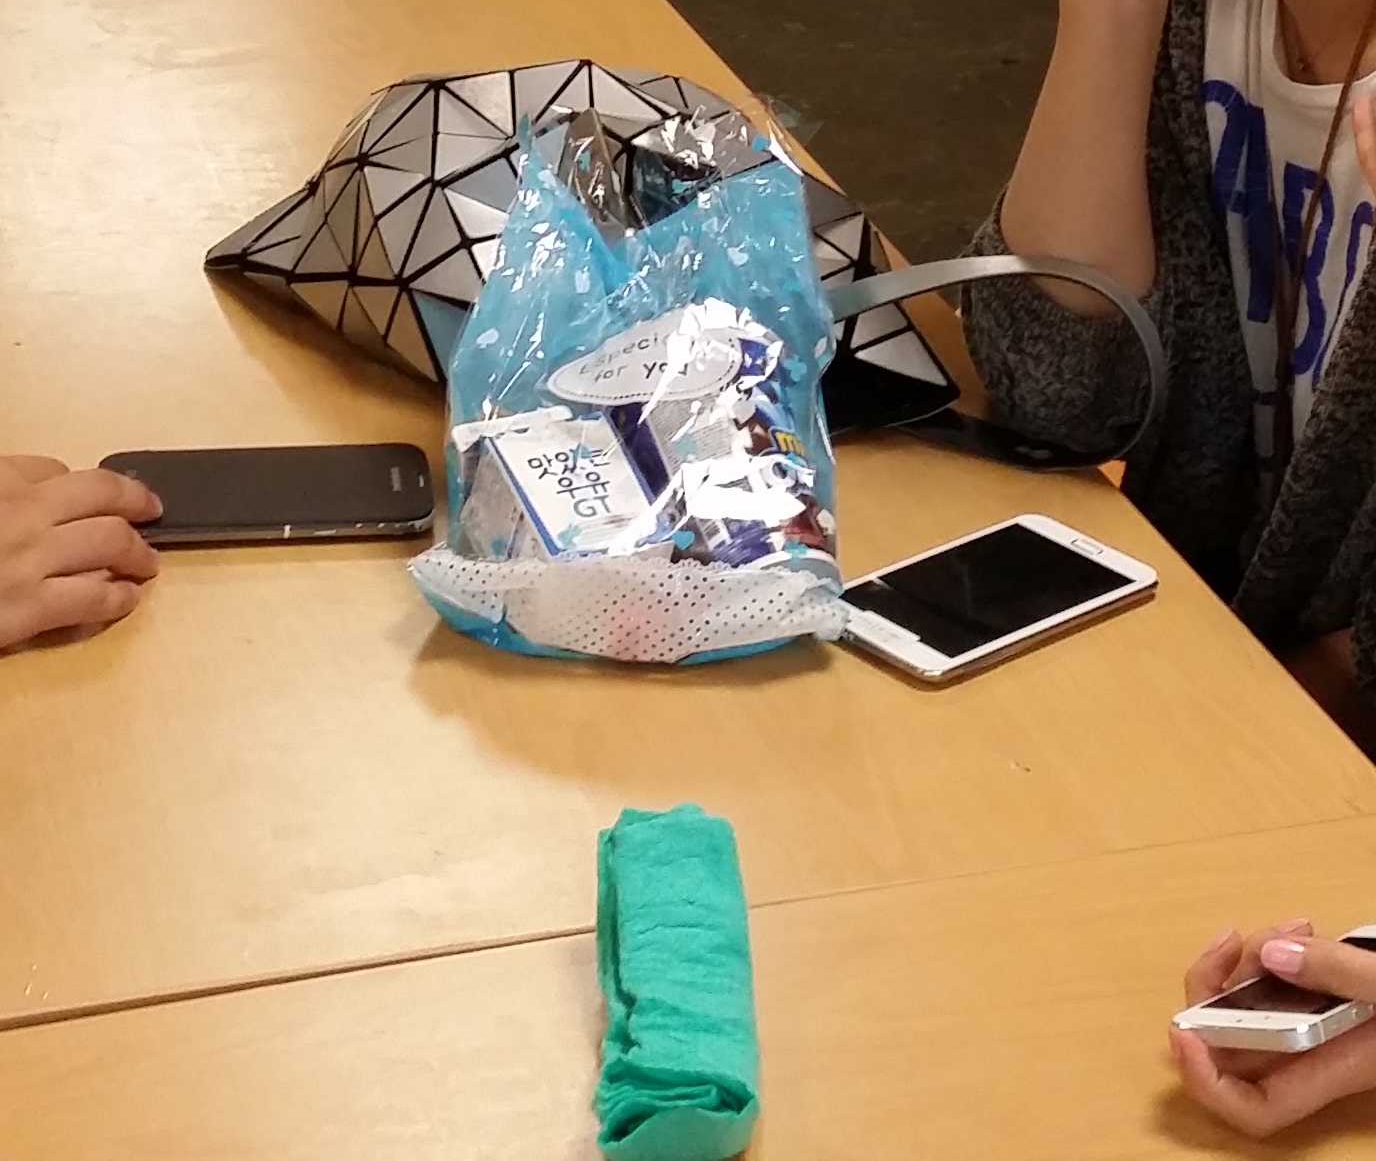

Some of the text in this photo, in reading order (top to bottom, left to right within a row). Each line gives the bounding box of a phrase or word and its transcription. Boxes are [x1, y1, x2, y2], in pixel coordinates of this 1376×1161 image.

[579, 332, 695, 375] Especi
[594, 365, 627, 384] for
[527, 443, 611, 480] 맛있는
[556, 471, 611, 499] 우유
[573, 494, 611, 518] GT
